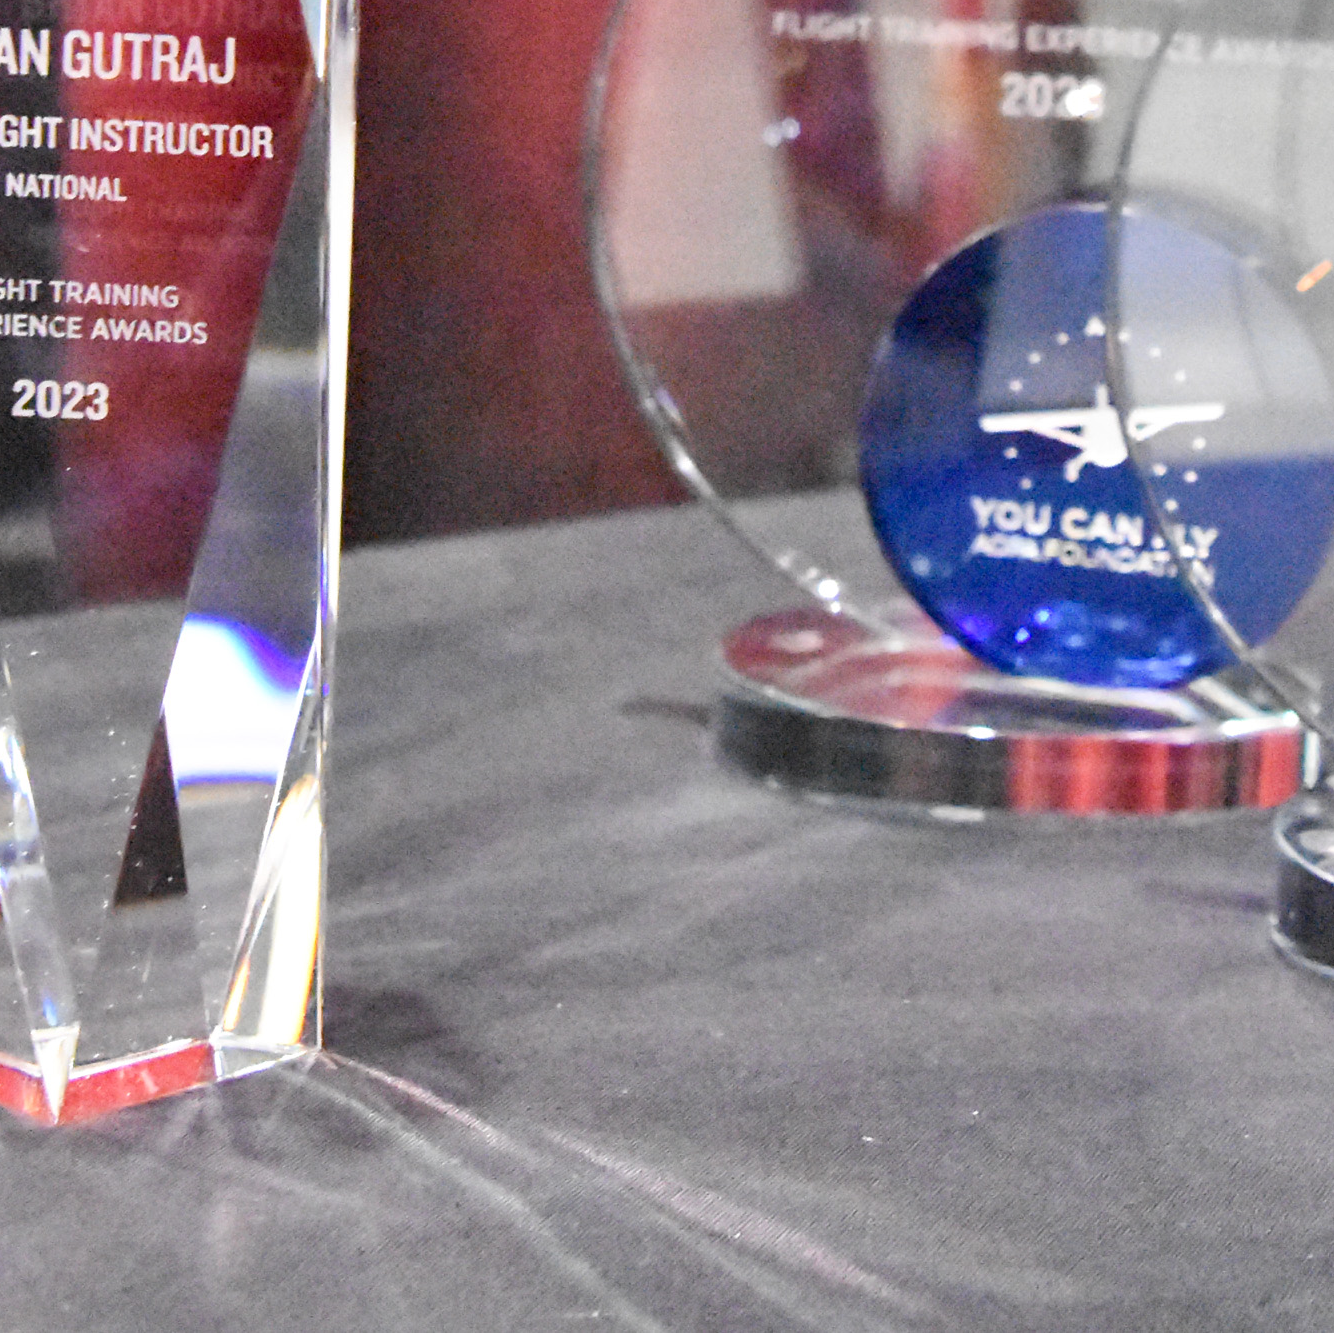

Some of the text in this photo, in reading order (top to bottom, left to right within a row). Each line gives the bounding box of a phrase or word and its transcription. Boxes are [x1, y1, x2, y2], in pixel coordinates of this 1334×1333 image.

[62, 30, 236, 84] GUTRAJ
[70, 118, 274, 159] INSTRUCTOR
[5, 172, 127, 202] NATIONAL
[49, 280, 179, 307] TRAINING
[91, 316, 207, 345] AWARDS
[11, 379, 109, 420] 2023
[970, 495, 1218, 559] YOU CAN LY
